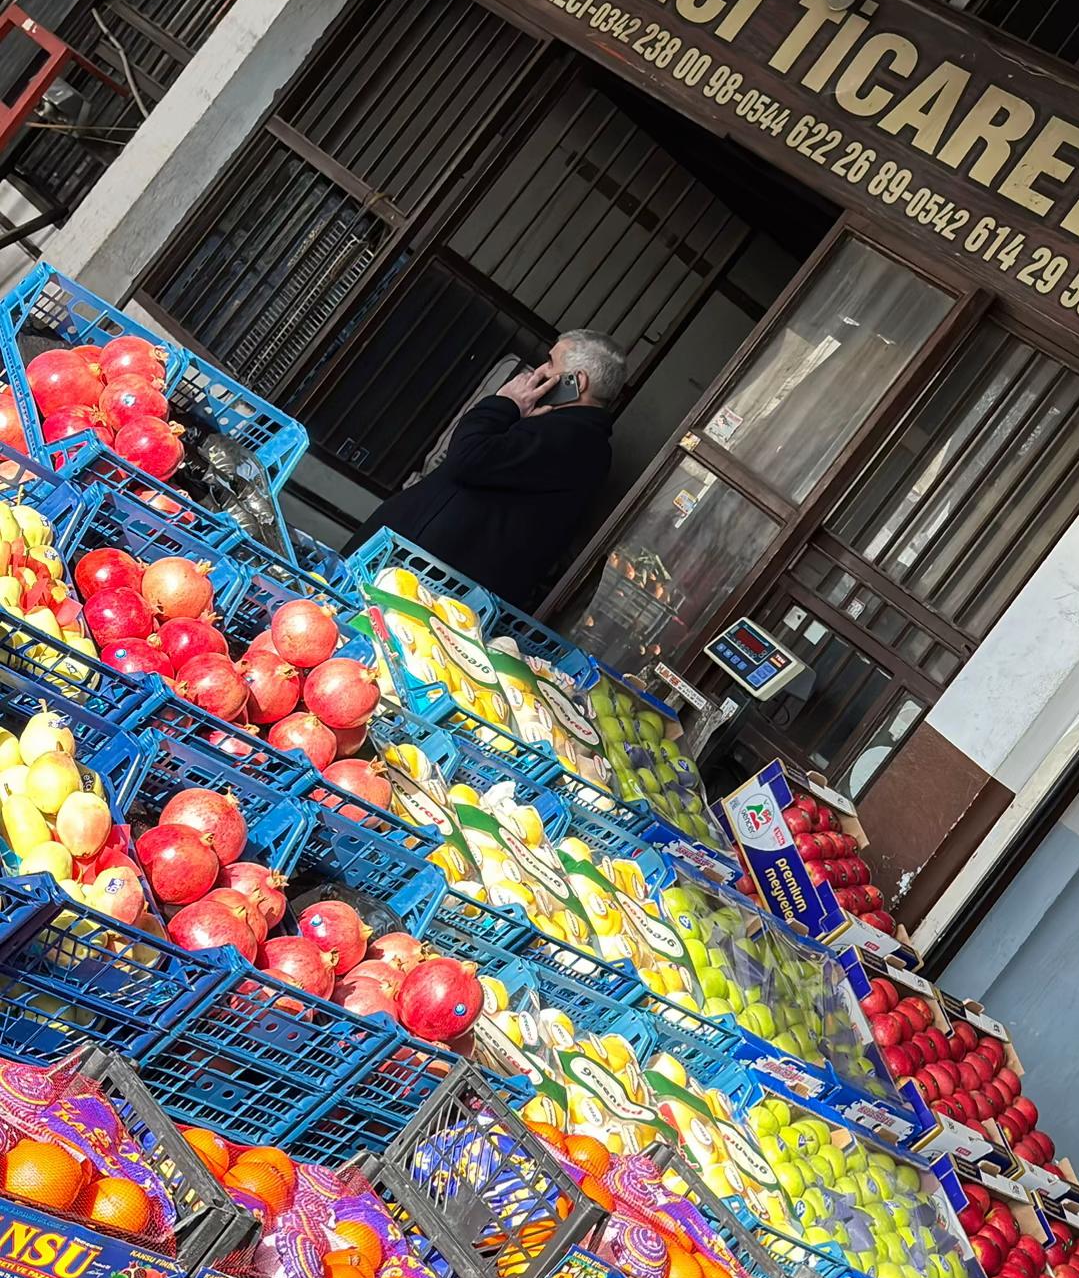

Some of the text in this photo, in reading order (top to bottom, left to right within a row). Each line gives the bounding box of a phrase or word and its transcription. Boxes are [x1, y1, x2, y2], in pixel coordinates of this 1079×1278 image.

[632, 22, 681, 70] 238
[673, 47, 713, 88] 00
[786, 114, 840, 167] 622
[830, 140, 876, 185] 26
[963, 215, 1028, 273] 614
[1016, 246, 1069, 295] 29
[775, 857, 808, 914] premium
[580, 1067, 644, 1116] greenred
